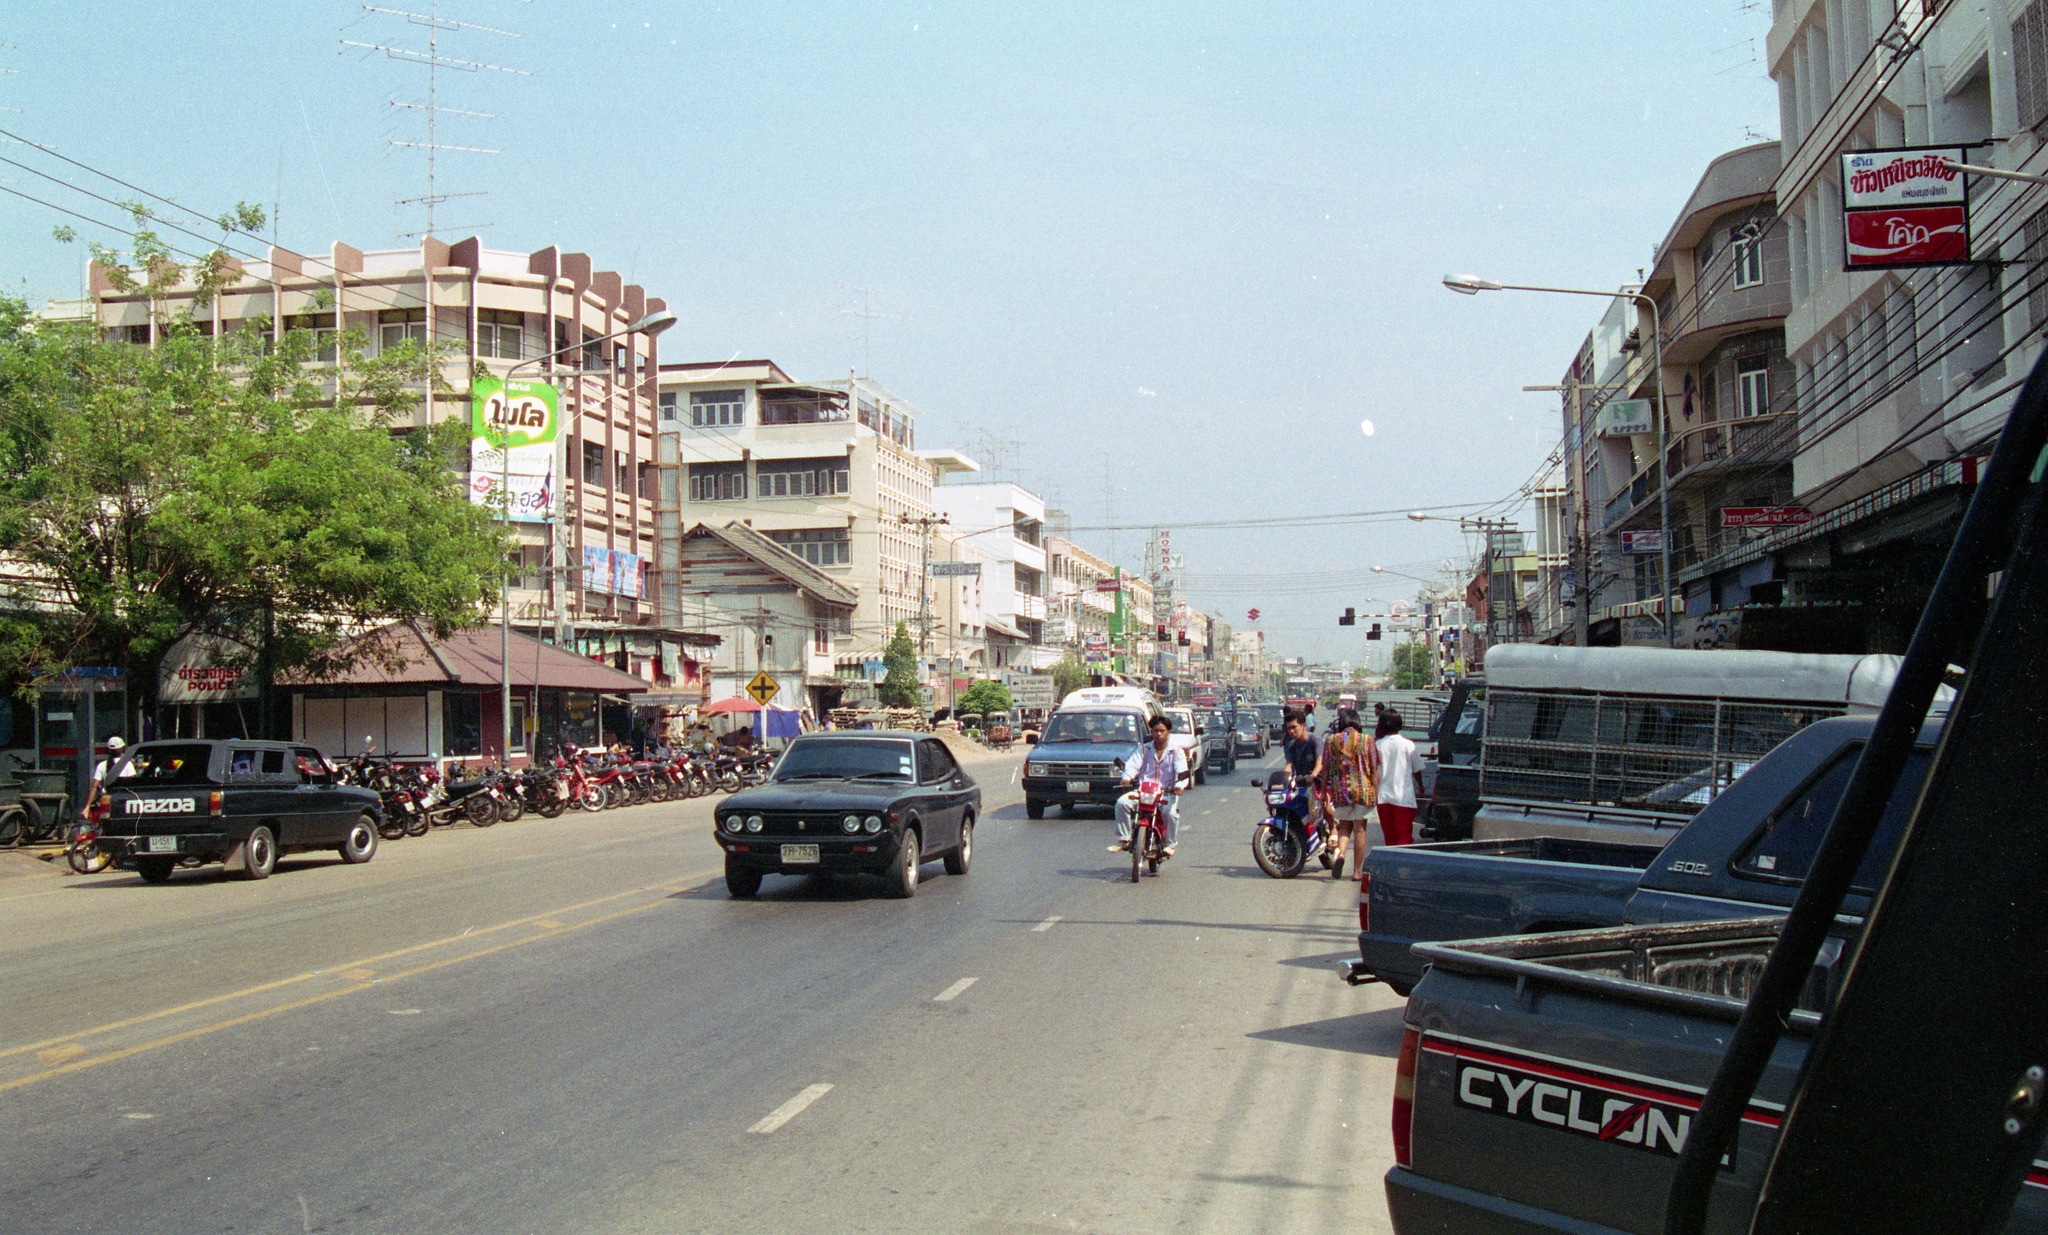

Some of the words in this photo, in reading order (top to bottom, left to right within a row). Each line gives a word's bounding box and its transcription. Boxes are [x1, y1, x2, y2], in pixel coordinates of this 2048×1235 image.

[1160, 530, 1170, 572] HONDA
[188, 681, 234, 691] POLICE
[126, 798, 195, 813] mazda
[1672, 861, 1708, 875] 602
[1460, 1066, 1729, 1166] CYCLON
